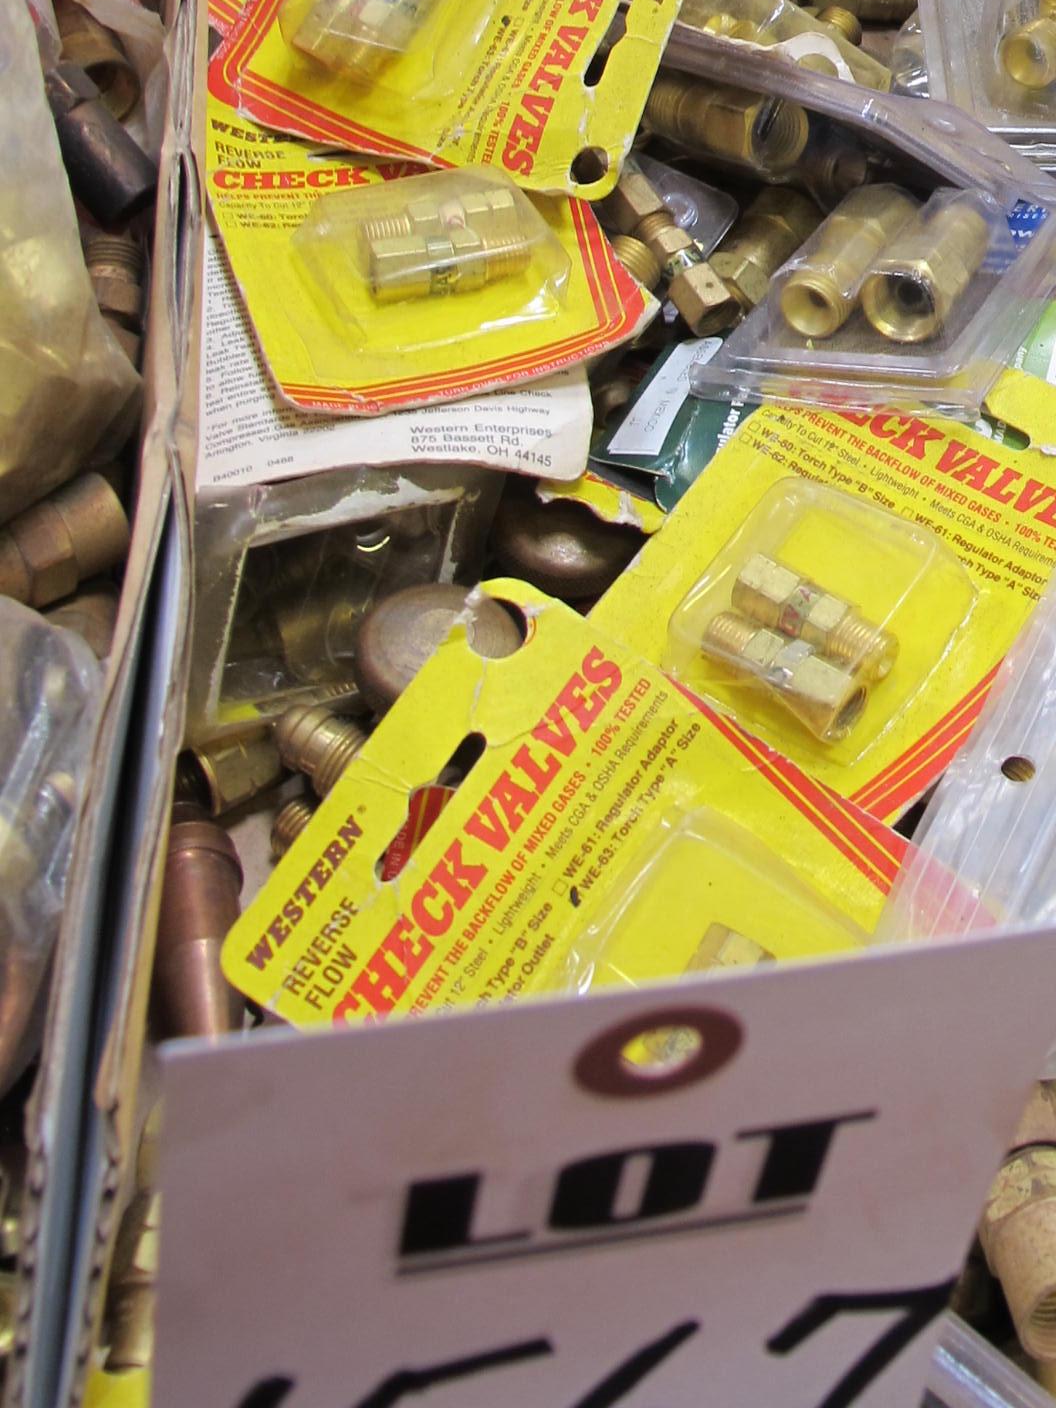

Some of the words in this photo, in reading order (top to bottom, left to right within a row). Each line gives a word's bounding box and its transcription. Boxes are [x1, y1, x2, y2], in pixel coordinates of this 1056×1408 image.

[502, 26, 589, 177] VALVES
[213, 166, 370, 189] CHECK
[215, 142, 285, 159] REVERSE
[218, 155, 262, 169] FLOW
[410, 424, 467, 434] Western
[474, 423, 552, 438] Enterprises
[411, 435, 437, 443] 875
[444, 434, 495, 444] Bassett
[501, 436, 523, 446] Rd.
[421, 406, 470, 415] Jefferson
[474, 405, 503, 415] Davis
[486, 445, 508, 457] OH
[515, 449, 552, 467] 44145
[796, 424, 807, 436] To
[807, 429, 823, 445] Cut
[869, 463, 920, 499] Lightweight
[929, 498, 957, 519] Meets
[956, 512, 978, 531] CGA
[975, 519, 985, 533] &
[984, 527, 1013, 547] OSHA
[803, 412, 850, 441] PREVENT
[849, 433, 867, 450] THE
[865, 445, 921, 481] BACKFLOW
[919, 475, 935, 489] OF
[935, 480, 969, 506] MIXED
[967, 499, 1002, 523] GASES
[1014, 522, 1043, 543] 100%
[798, 447, 828, 472] Torch
[827, 465, 854, 486] Type
[872, 491, 896, 510] Size
[951, 533, 1006, 568] Regulator
[1005, 559, 1048, 587] Adaptor
[975, 561, 1001, 583] Type
[615, 690, 669, 761] Requirements
[587, 792, 598, 805] &
[592, 761, 621, 794] OSHA
[332, 838, 488, 1030] CHECK
[463, 645, 622, 853] VALVES
[444, 939, 469, 966] THE
[462, 872, 517, 942] BACKFLOW
[511, 853, 529, 875] OF
[525, 811, 557, 853] MIXED
[548, 770, 587, 812] GASES
[591, 724, 621, 758] 100%
[613, 677, 652, 724] TESTED
[547, 825, 574, 860] Meets
[568, 799, 590, 827] CGA
[486, 957, 516, 990] Type
[527, 902, 553, 932] Size
[563, 827, 600, 880] WE-61:
[596, 769, 643, 832] Regulator
[638, 718, 679, 773] Adaptor
[521, 933, 556, 976] Outlet
[579, 845, 618, 891] WE-63:
[611, 806, 644, 850] Torch
[639, 772, 666, 808] Type
[676, 722, 702, 751] Size
[245, 814, 364, 972] WESTERN
[492, 872, 544, 937] Lightweight
[282, 896, 360, 996] REVERSE
[305, 943, 359, 1010] FLOW
[463, 947, 489, 978] Steel
[400, 1111, 878, 1256] LOT
